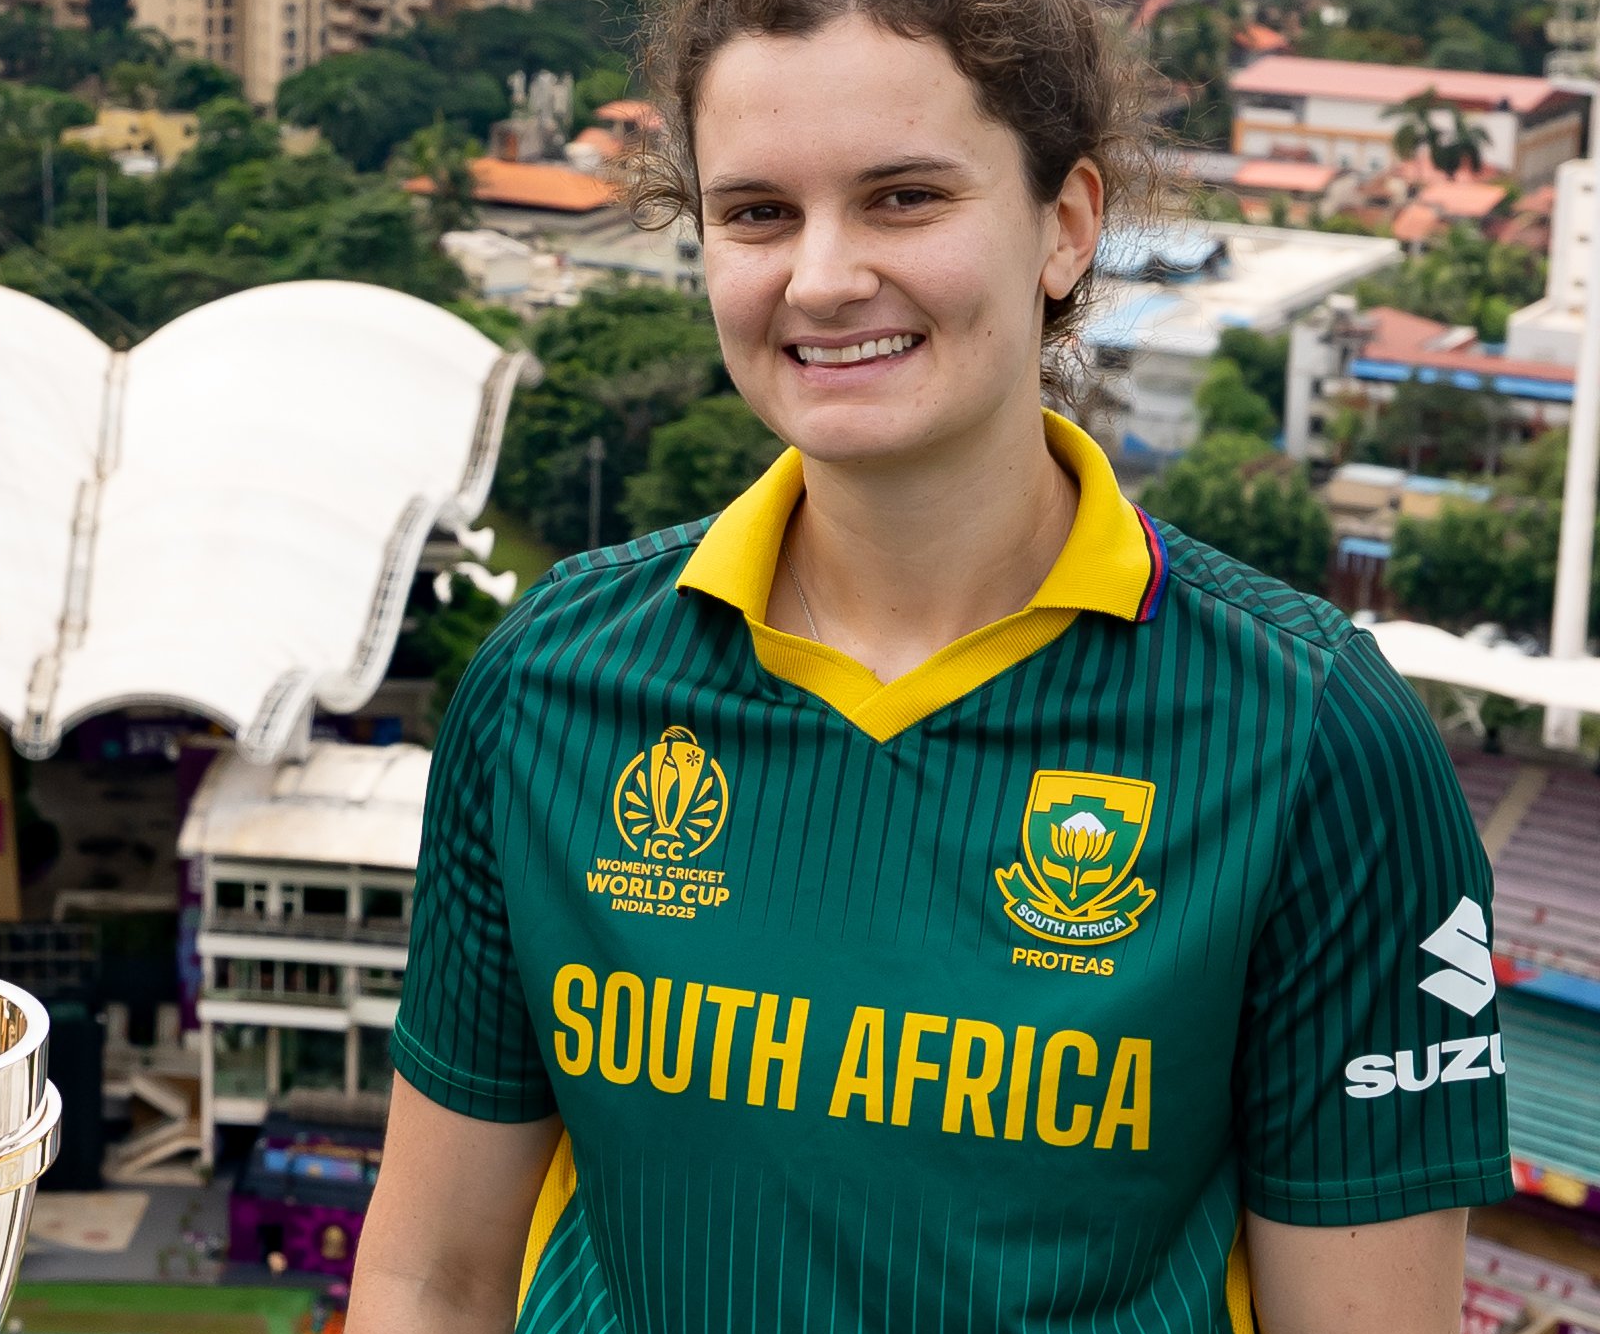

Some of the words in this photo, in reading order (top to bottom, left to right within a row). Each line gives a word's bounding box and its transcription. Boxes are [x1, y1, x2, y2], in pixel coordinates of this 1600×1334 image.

[643, 839, 685, 861] ICC
[596, 858, 663, 876] WOMEN'S
[666, 867, 725, 883] CRICKET
[586, 872, 675, 900] WORLD
[680, 884, 730, 907] CUP
[611, 899, 653, 914] INDIA
[656, 904, 696, 919] 2025
[1016, 904, 1065, 935] SOUTH
[1068, 917, 1126, 937] AFRICA
[1012, 947, 1114, 976] PROTEAS
[552, 963, 811, 1111] SOUTH
[828, 1004, 1152, 1151] AFRICA
